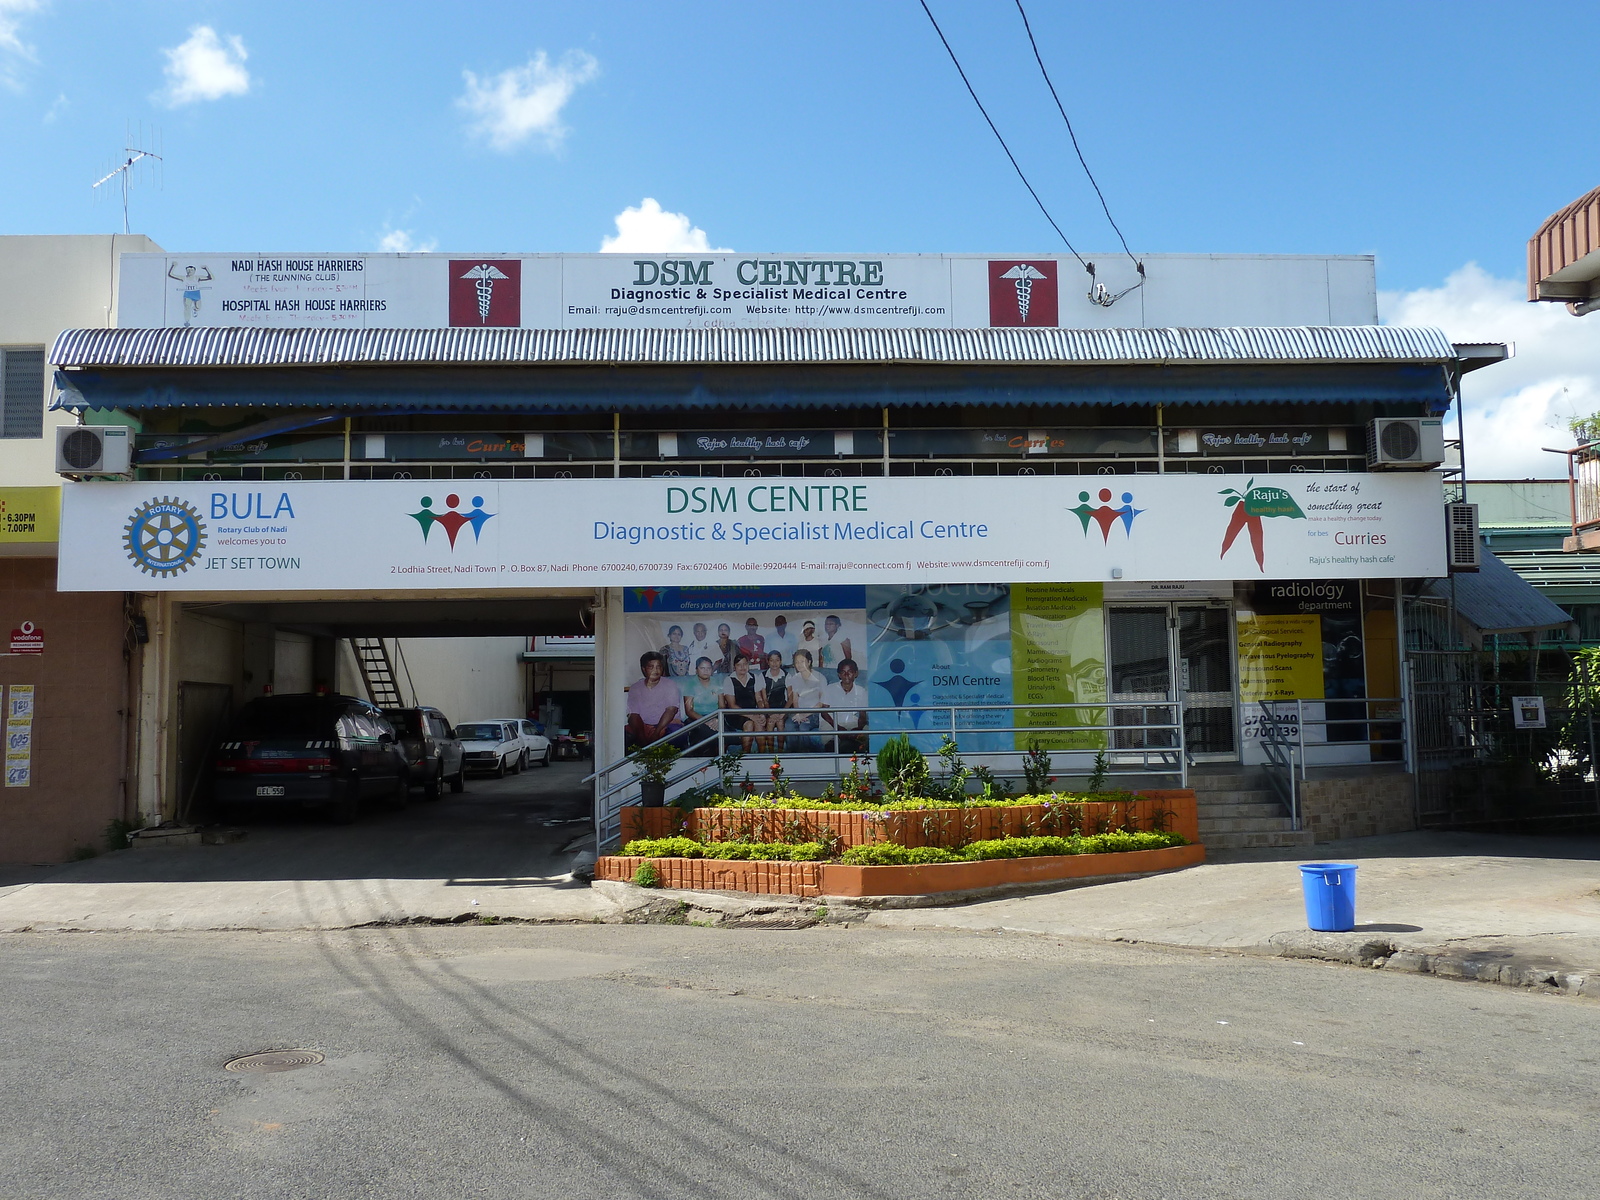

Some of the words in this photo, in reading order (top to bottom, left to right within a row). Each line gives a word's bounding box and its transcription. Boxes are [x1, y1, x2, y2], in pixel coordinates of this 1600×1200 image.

[231, 260, 254, 272] NADI
[257, 260, 282, 272] HASH
[286, 260, 314, 272] HOUSE
[317, 260, 364, 272] HARRIERS
[273, 274, 312, 282] RUNNING
[315, 273, 340, 282] CLUB)
[632, 260, 714, 286] DSM
[736, 260, 884, 286] CENTRE
[611, 288, 691, 302] Diagnostic
[696, 288, 707, 300] &
[712, 288, 789, 302] Specialist
[792, 288, 851, 300] Medical
[856, 289, 908, 300] Centre
[222, 299, 271, 312] HOSPITAL
[274, 299, 300, 311] HASH
[305, 299, 336, 311] HOUSE
[339, 299, 387, 311] HARRIERS
[568, 305, 601, 315] Email:
[746, 305, 791, 315] Website:
[466, 439, 526, 453] Curries
[1008, 435, 1066, 448] Curries
[1305, 481, 1321, 493] the
[1323, 482, 1347, 493] start
[1350, 481, 1361, 496] of
[666, 486, 739, 514] DSM
[747, 485, 868, 513] CENTRE
[1252, 489, 1289, 503] Raju's
[149, 504, 183, 516] ROTARY
[210, 492, 296, 520] BULA
[1250, 505, 1277, 514] healthy
[1277, 505, 1295, 513] hash
[1306, 499, 1353, 514] something
[1356, 500, 1383, 514] great
[7, 513, 36, 522] 6.30PM
[1328, 515, 1347, 523] healthy
[7, 523, 35, 533] 7.00PM
[217, 526, 242, 535] Rotary
[243, 526, 260, 534] Club
[593, 521, 706, 545] Diagnostic
[711, 522, 727, 541] &
[732, 521, 830, 545] Specialist
[833, 520, 914, 541] Medical
[919, 519, 989, 539] Centre
[217, 537, 259, 546] welcomes
[260, 538, 276, 547] you
[1334, 531, 1387, 545] Curries
[146, 558, 185, 568] INTERNATIONAL
[205, 557, 227, 570] JET
[231, 557, 255, 570] SET
[257, 557, 301, 570] TOWN
[1309, 556, 1331, 565] Raju's
[1331, 555, 1359, 565] healthy
[1359, 555, 1378, 563] hash
[390, 566, 396, 574] 2
[397, 565, 425, 574] Lodhia
[427, 565, 454, 575] Street,
[454, 565, 473, 573] Nadi
[475, 565, 497, 573] Town
[520, 564, 535, 573] Box
[550, 563, 569, 573] Nadi
[572, 563, 599, 573] Phone
[1271, 582, 1345, 600] radiology
[680, 600, 700, 609] offers
[700, 601, 714, 610] you
[714, 600, 726, 608] the
[727, 601, 742, 610] very
[742, 600, 757, 608] best
[758, 600, 766, 608] in
[766, 600, 790, 609] private
[791, 599, 828, 607] healthcare
[1298, 600, 1353, 611] department
[1263, 640, 1303, 648] Radiography
[932, 675, 960, 687] DSM
[962, 675, 1001, 686] Centre
